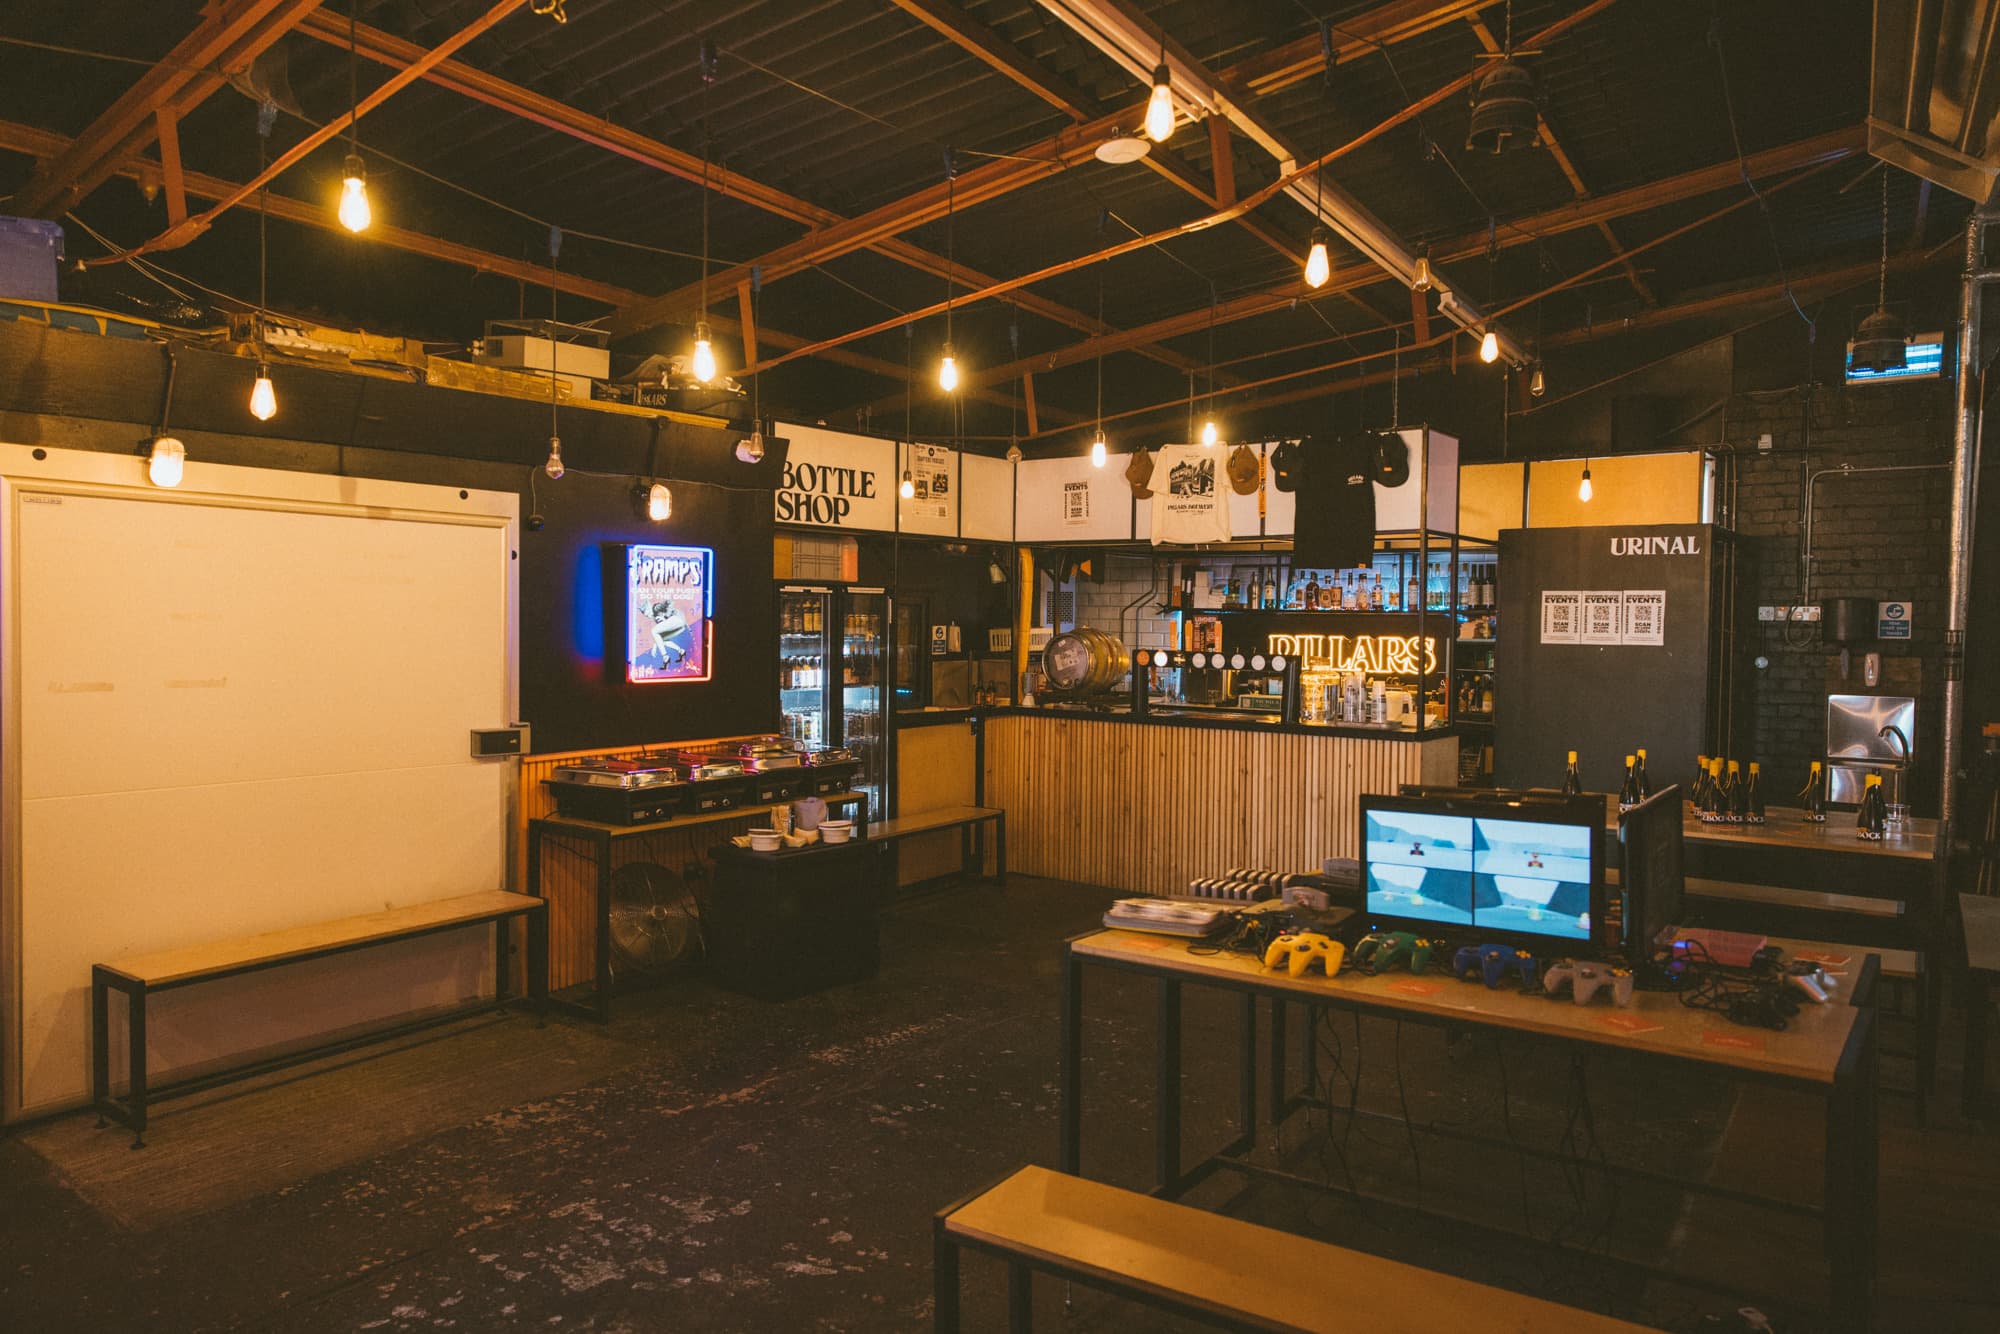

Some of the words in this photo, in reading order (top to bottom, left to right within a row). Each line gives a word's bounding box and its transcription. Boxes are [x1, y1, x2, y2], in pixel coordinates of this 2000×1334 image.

[781, 461, 876, 499] BOTTLE
[777, 491, 850, 524] SHOP
[1610, 536, 1700, 555] URINAL
[1268, 634, 1437, 675] PILLARS
